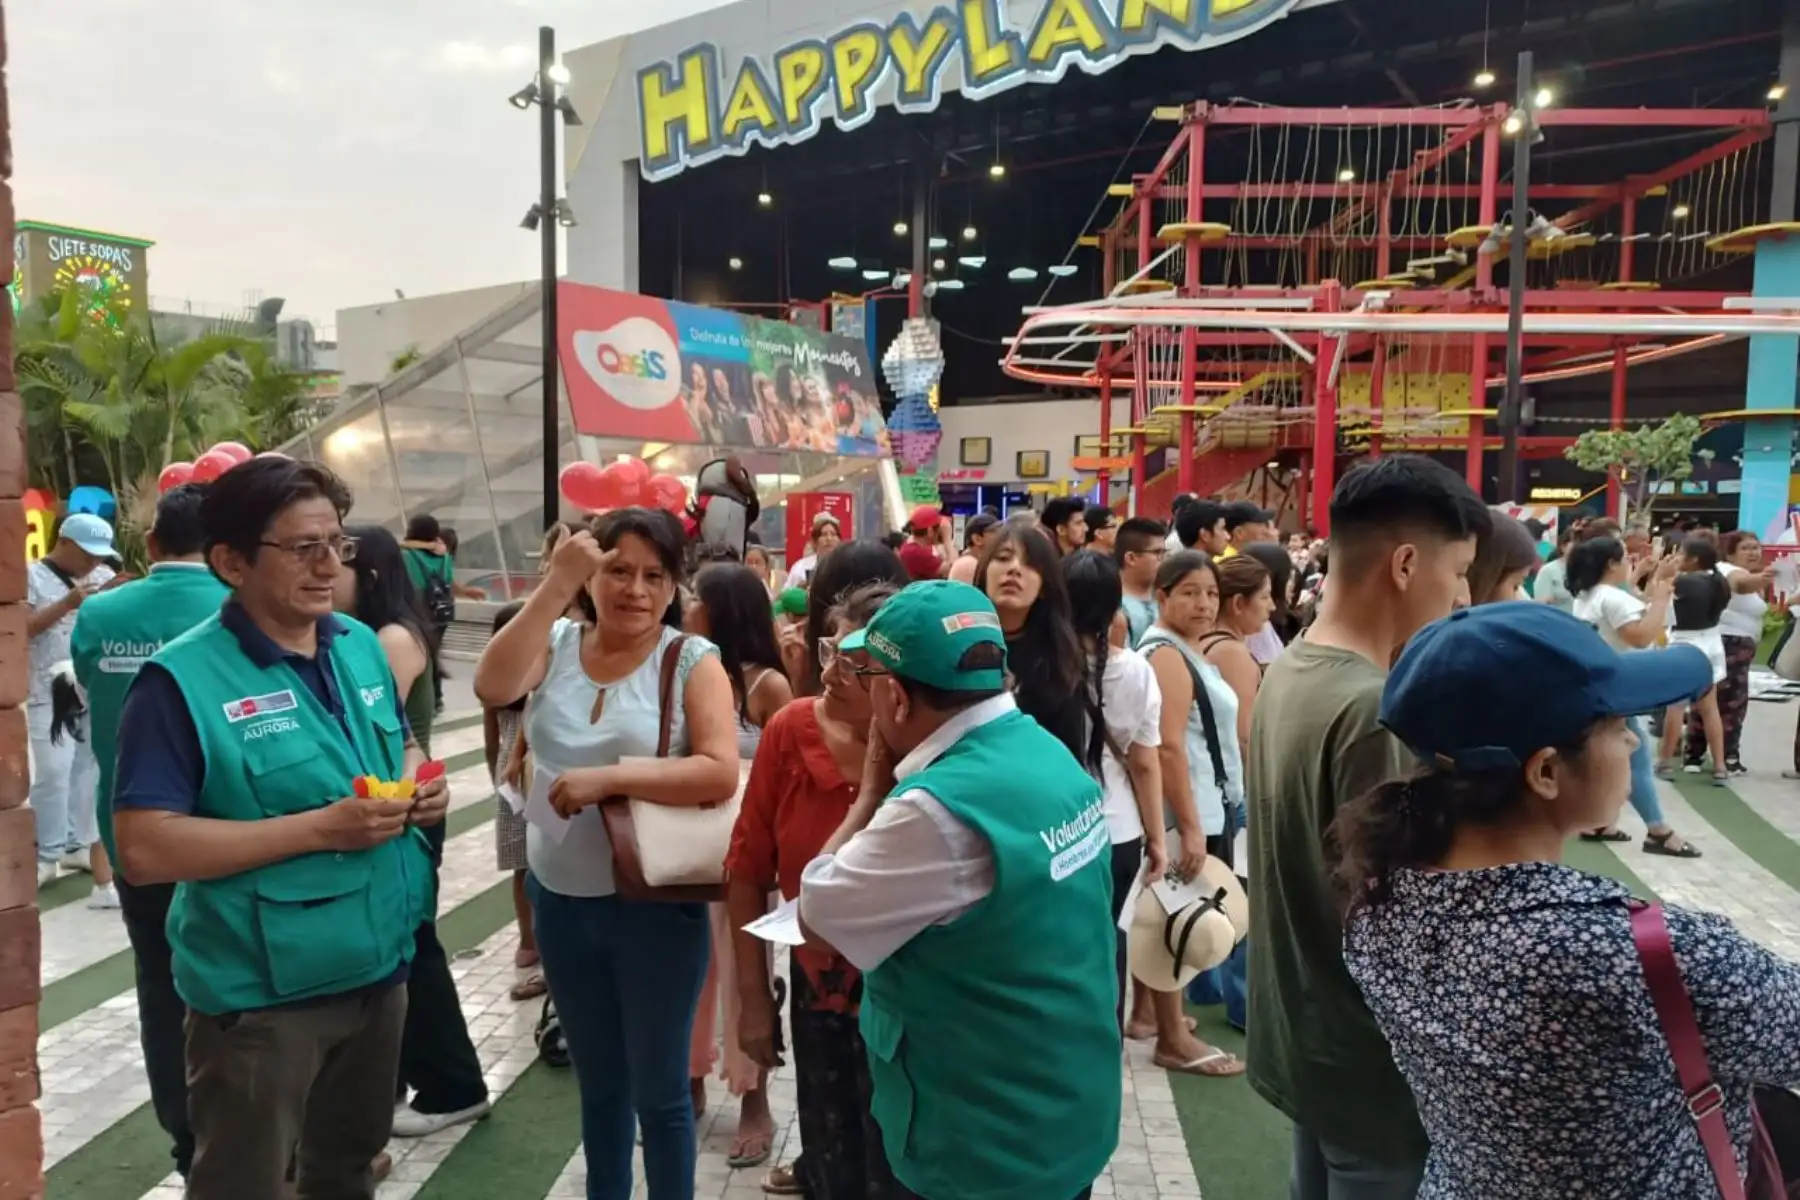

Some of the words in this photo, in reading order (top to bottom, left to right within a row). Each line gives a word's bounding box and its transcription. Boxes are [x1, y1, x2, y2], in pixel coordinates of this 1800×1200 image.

[638, 0, 1275, 164] HAPPYLA
[48, 236, 86, 261] SIETE
[89, 242, 132, 272] SOPAS
[243, 720, 300, 742] AURORA
